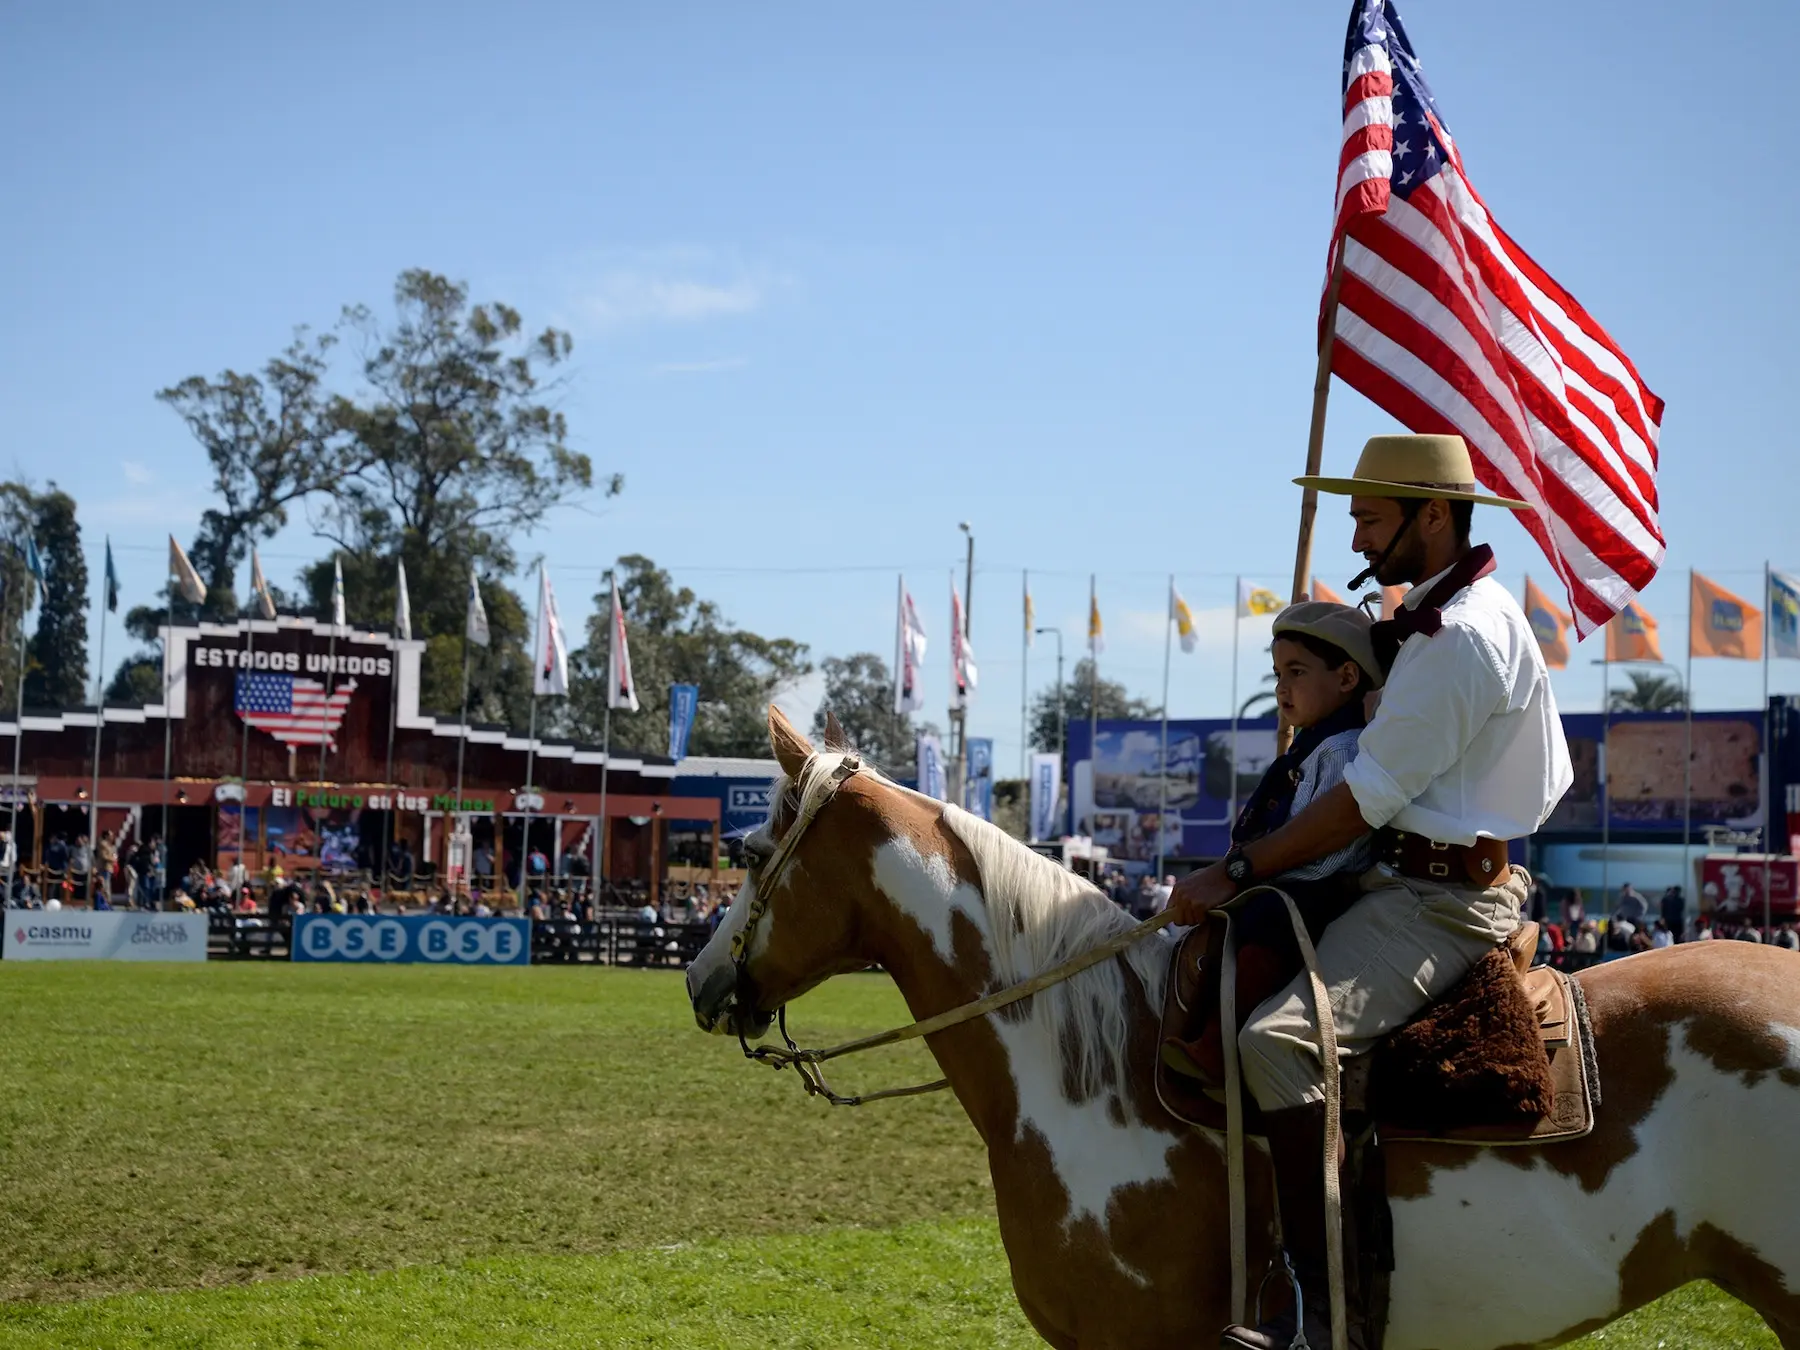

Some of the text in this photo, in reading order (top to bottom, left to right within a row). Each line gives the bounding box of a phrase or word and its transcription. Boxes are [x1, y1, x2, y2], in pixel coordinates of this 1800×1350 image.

[195, 647, 392, 676] ESTADOS UNIDOS
[271, 787, 291, 807] El
[368, 794, 392, 810] en
[396, 791, 428, 811] tus
[28, 925, 92, 940] casmu
[311, 925, 397, 952] BSE
[427, 928, 512, 955] BSE
